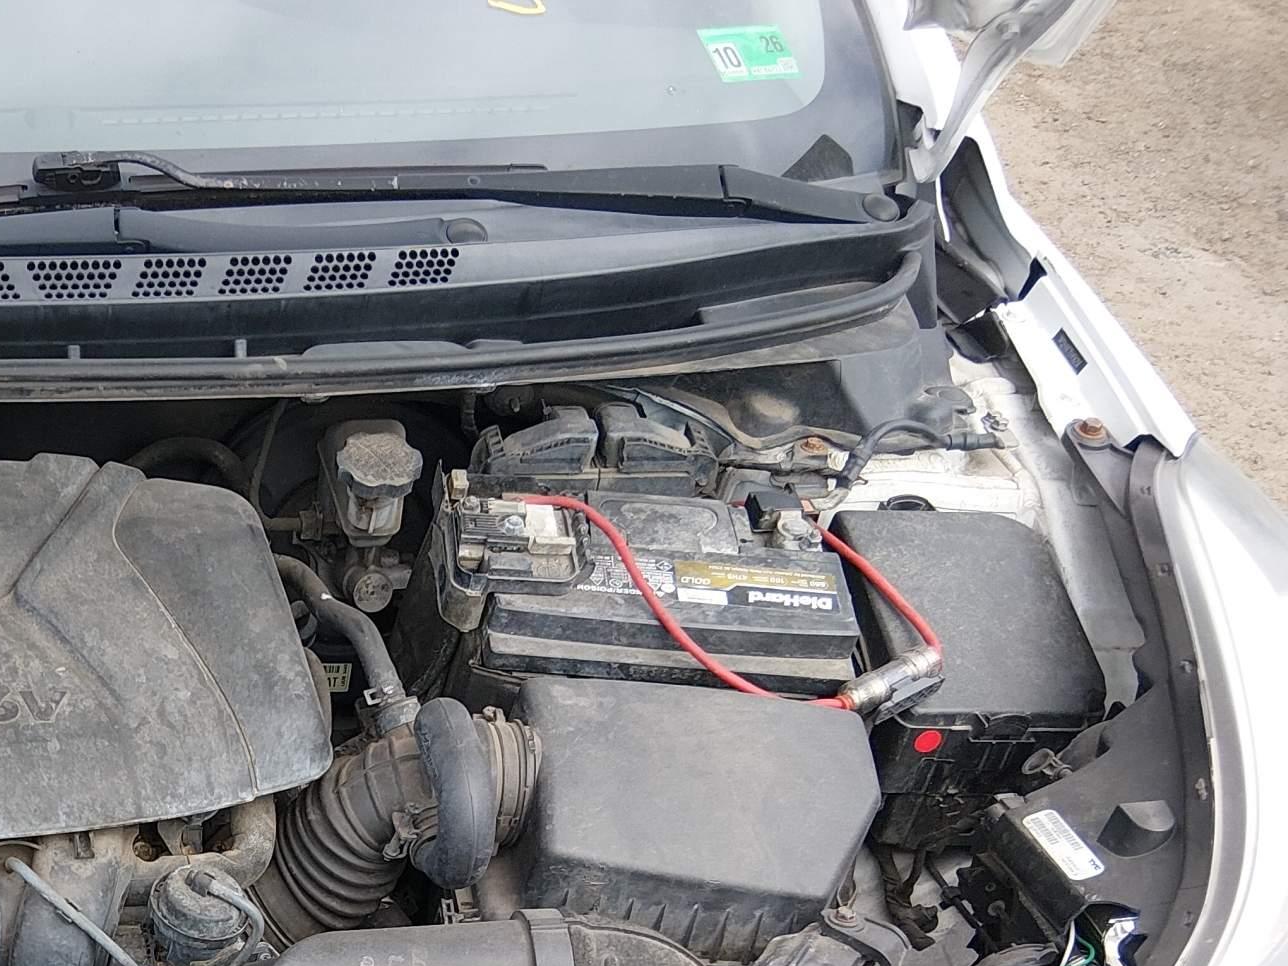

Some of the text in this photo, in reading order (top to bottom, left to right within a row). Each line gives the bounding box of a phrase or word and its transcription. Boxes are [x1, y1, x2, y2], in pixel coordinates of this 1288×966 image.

[759, 35, 785, 53] 26
[712, 46, 742, 69] 10
[681, 576, 712, 586] GOLD
[747, 590, 833, 611] DieHard
[1088, 858, 1102, 871] TYC
